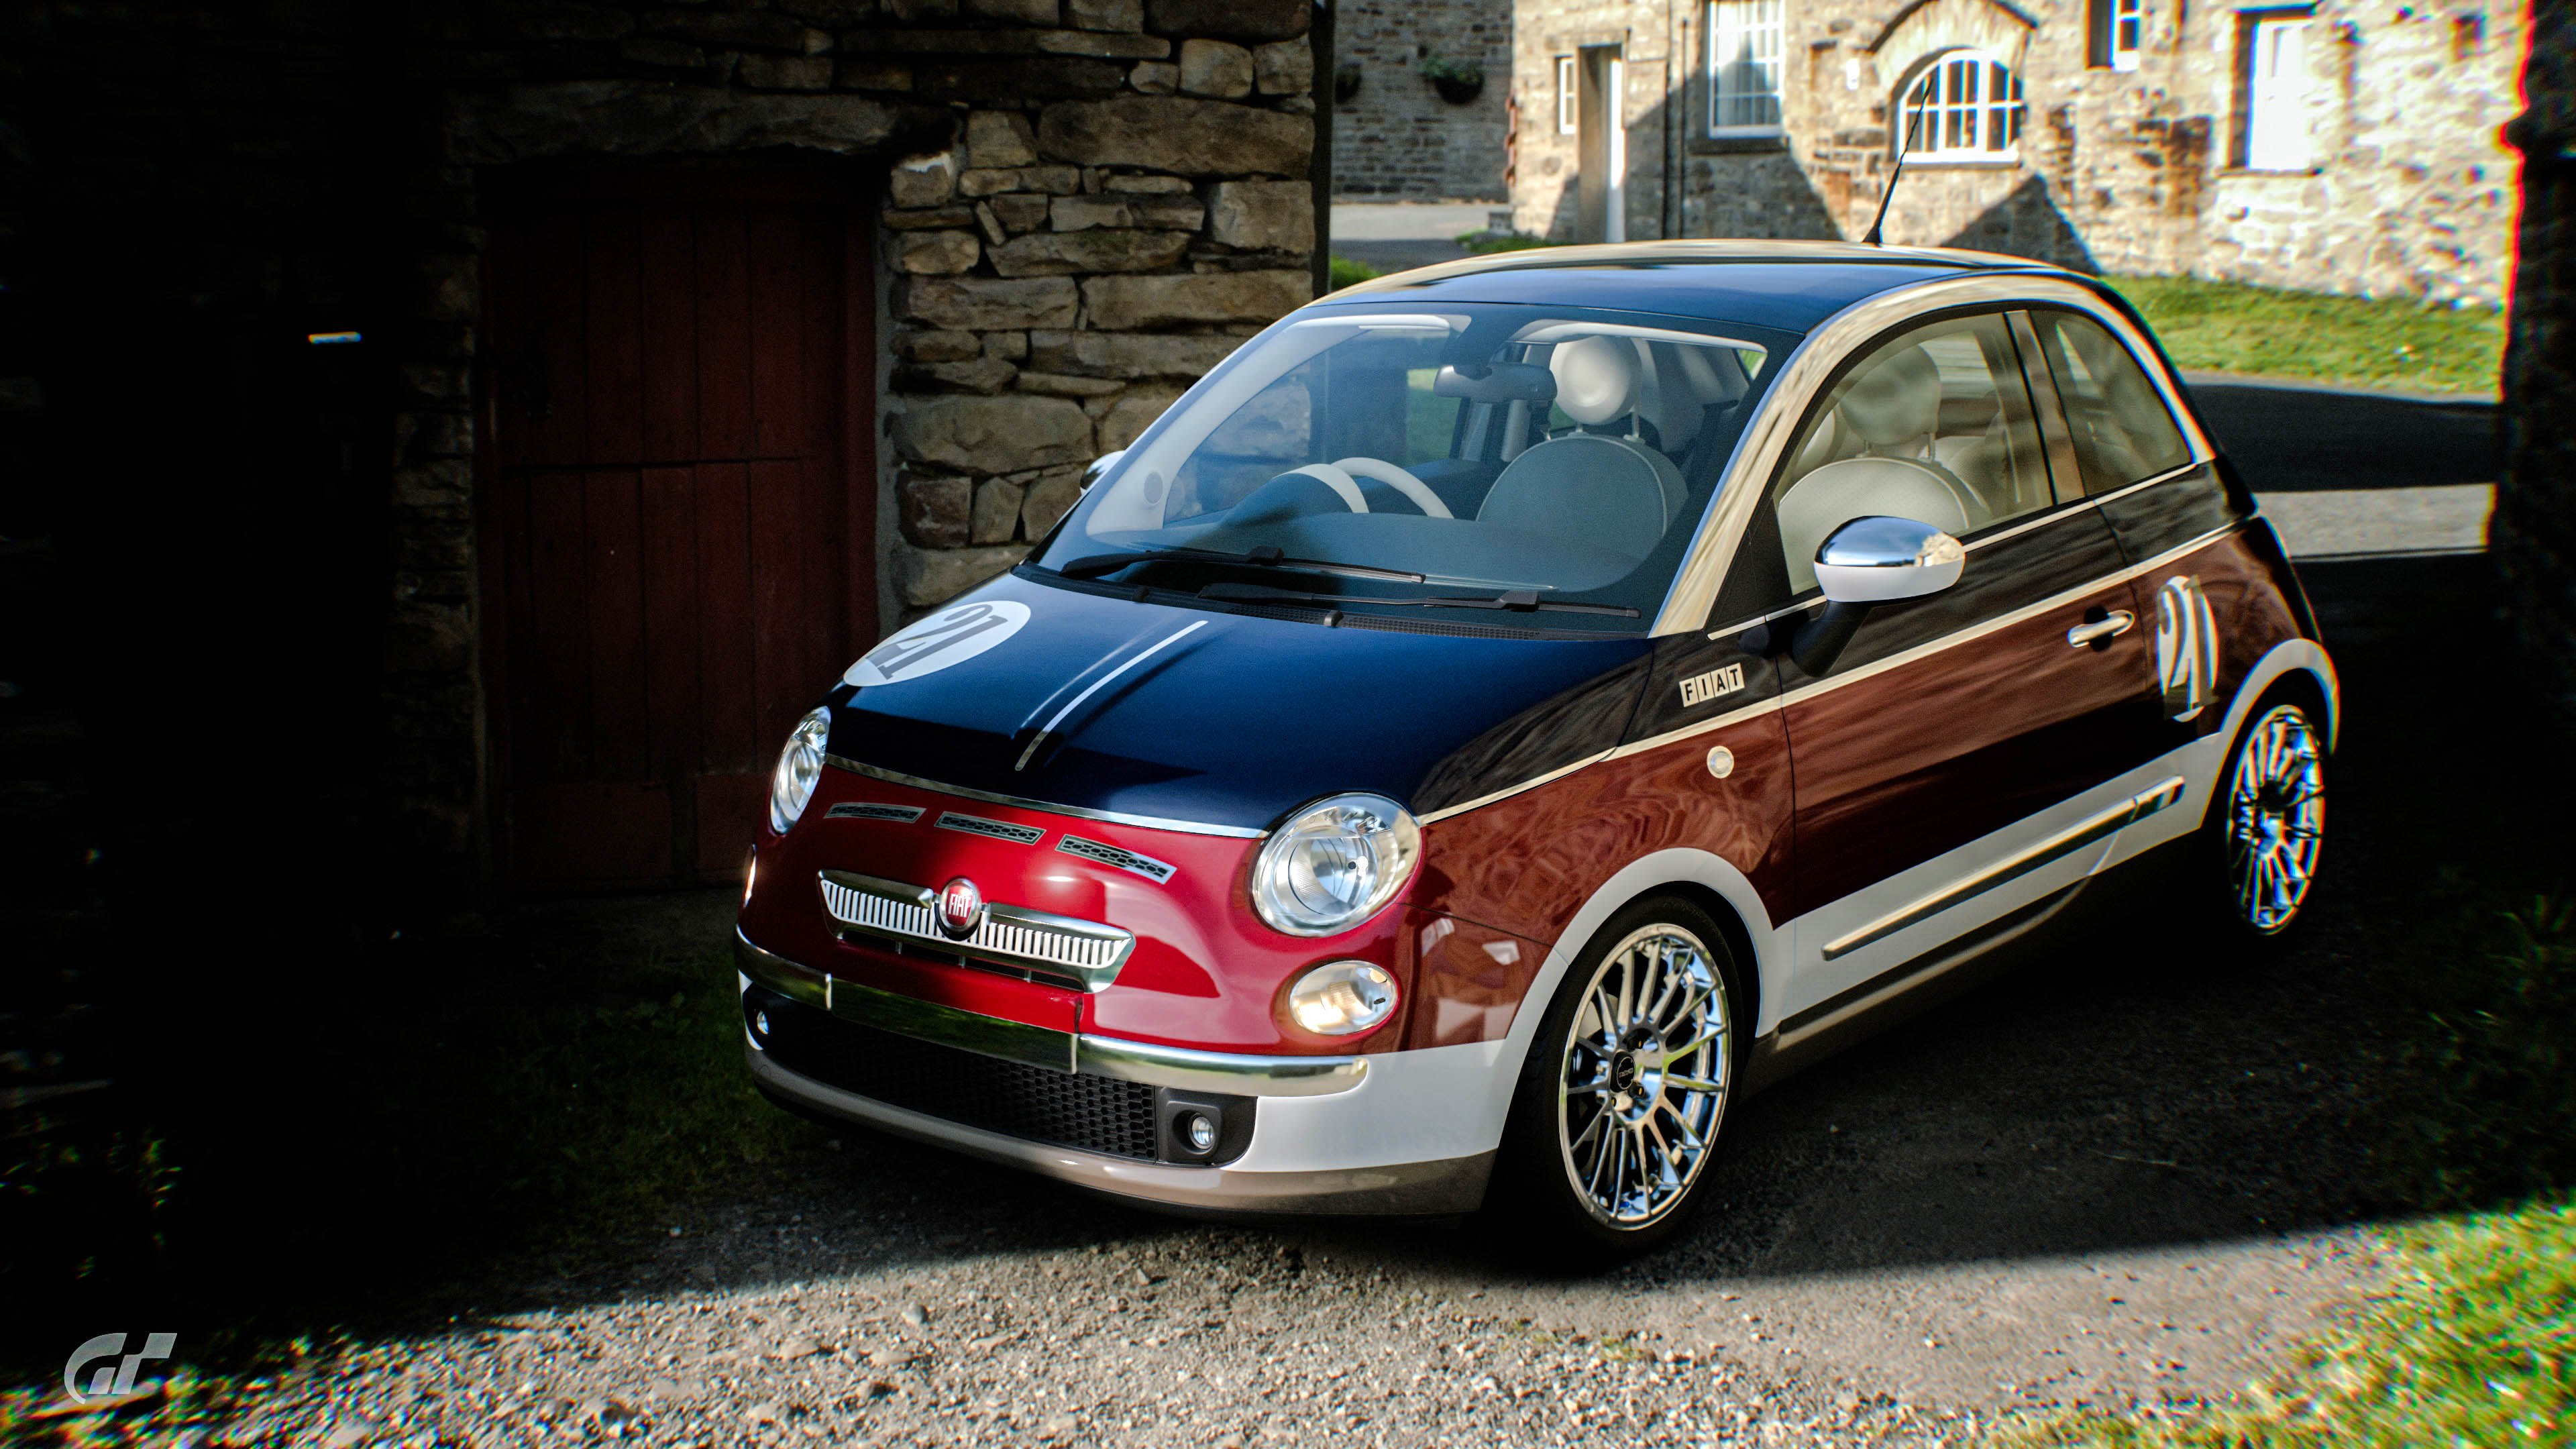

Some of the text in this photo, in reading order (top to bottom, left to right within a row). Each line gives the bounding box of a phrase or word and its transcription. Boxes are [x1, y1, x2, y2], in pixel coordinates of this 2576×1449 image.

[865, 604, 1008, 680] 21
[2157, 574, 2220, 722] 21
[1685, 669, 1738, 701] FIAT
[948, 894, 972, 918] FIAT
